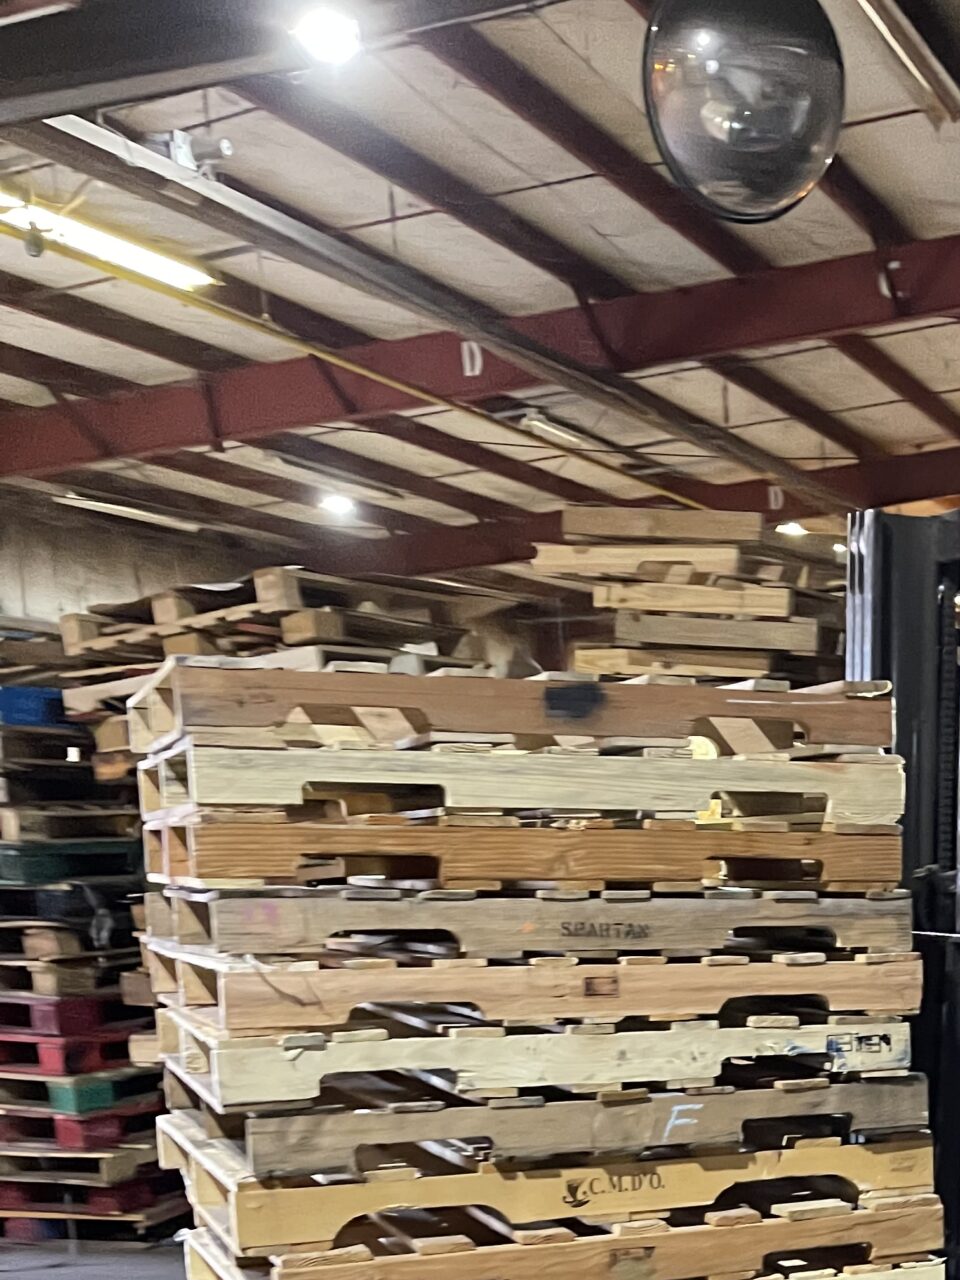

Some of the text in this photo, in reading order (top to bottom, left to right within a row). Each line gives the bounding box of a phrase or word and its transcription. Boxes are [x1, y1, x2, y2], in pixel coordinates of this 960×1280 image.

[460, 340, 483, 376] D
[768, 485, 784, 510] D
[662, 1103, 704, 1143] F
